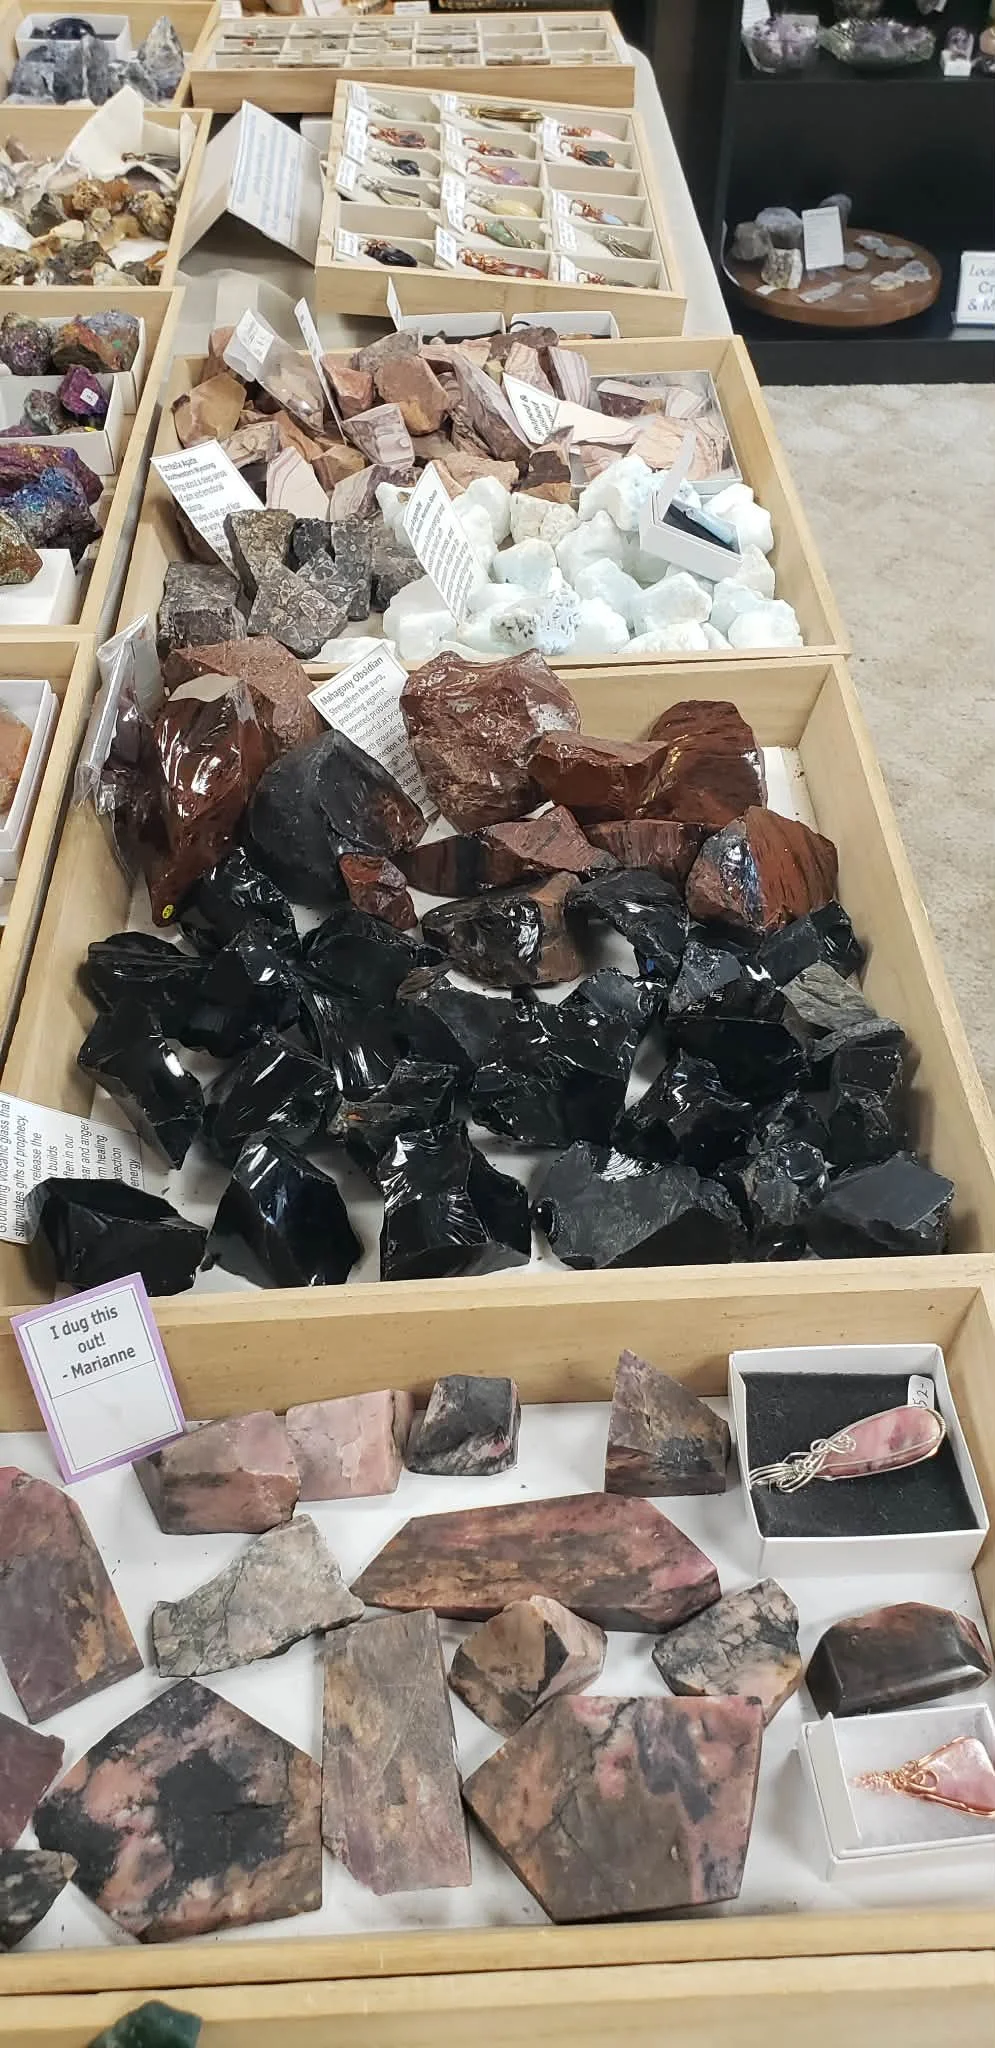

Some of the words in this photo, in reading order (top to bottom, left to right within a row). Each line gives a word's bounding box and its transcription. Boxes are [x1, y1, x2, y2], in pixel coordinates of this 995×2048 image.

[320, 679, 355, 705] Mahagony
[352, 656, 384, 682] Obsidian
[329, 690, 361, 716] Strengthen
[358, 682, 371, 694] the
[338, 703, 368, 727] protecting
[367, 687, 386, 707] against
[375, 722, 404, 747] grounding
[14, 1115, 29, 1157] prophecy.
[30, 1132, 42, 1147] the
[65, 1133, 74, 1149] our
[80, 1120, 92, 1146] anger
[14, 1156, 25, 1167] of
[30, 1148, 42, 1181] release
[46, 1145, 58, 1171] builds
[62, 1150, 73, 1159] in
[79, 1146, 91, 1164] and
[14, 1169, 28, 1189] gifts
[63, 1160, 75, 1177] ften
[12, 1191, 25, 1237] stimulates
[50, 1325, 59, 1340] I
[62, 1317, 90, 1338] dug
[91, 1306, 119, 1325] this
[78, 1332, 107, 1354] out!
[71, 1346, 137, 1379] Marianne
